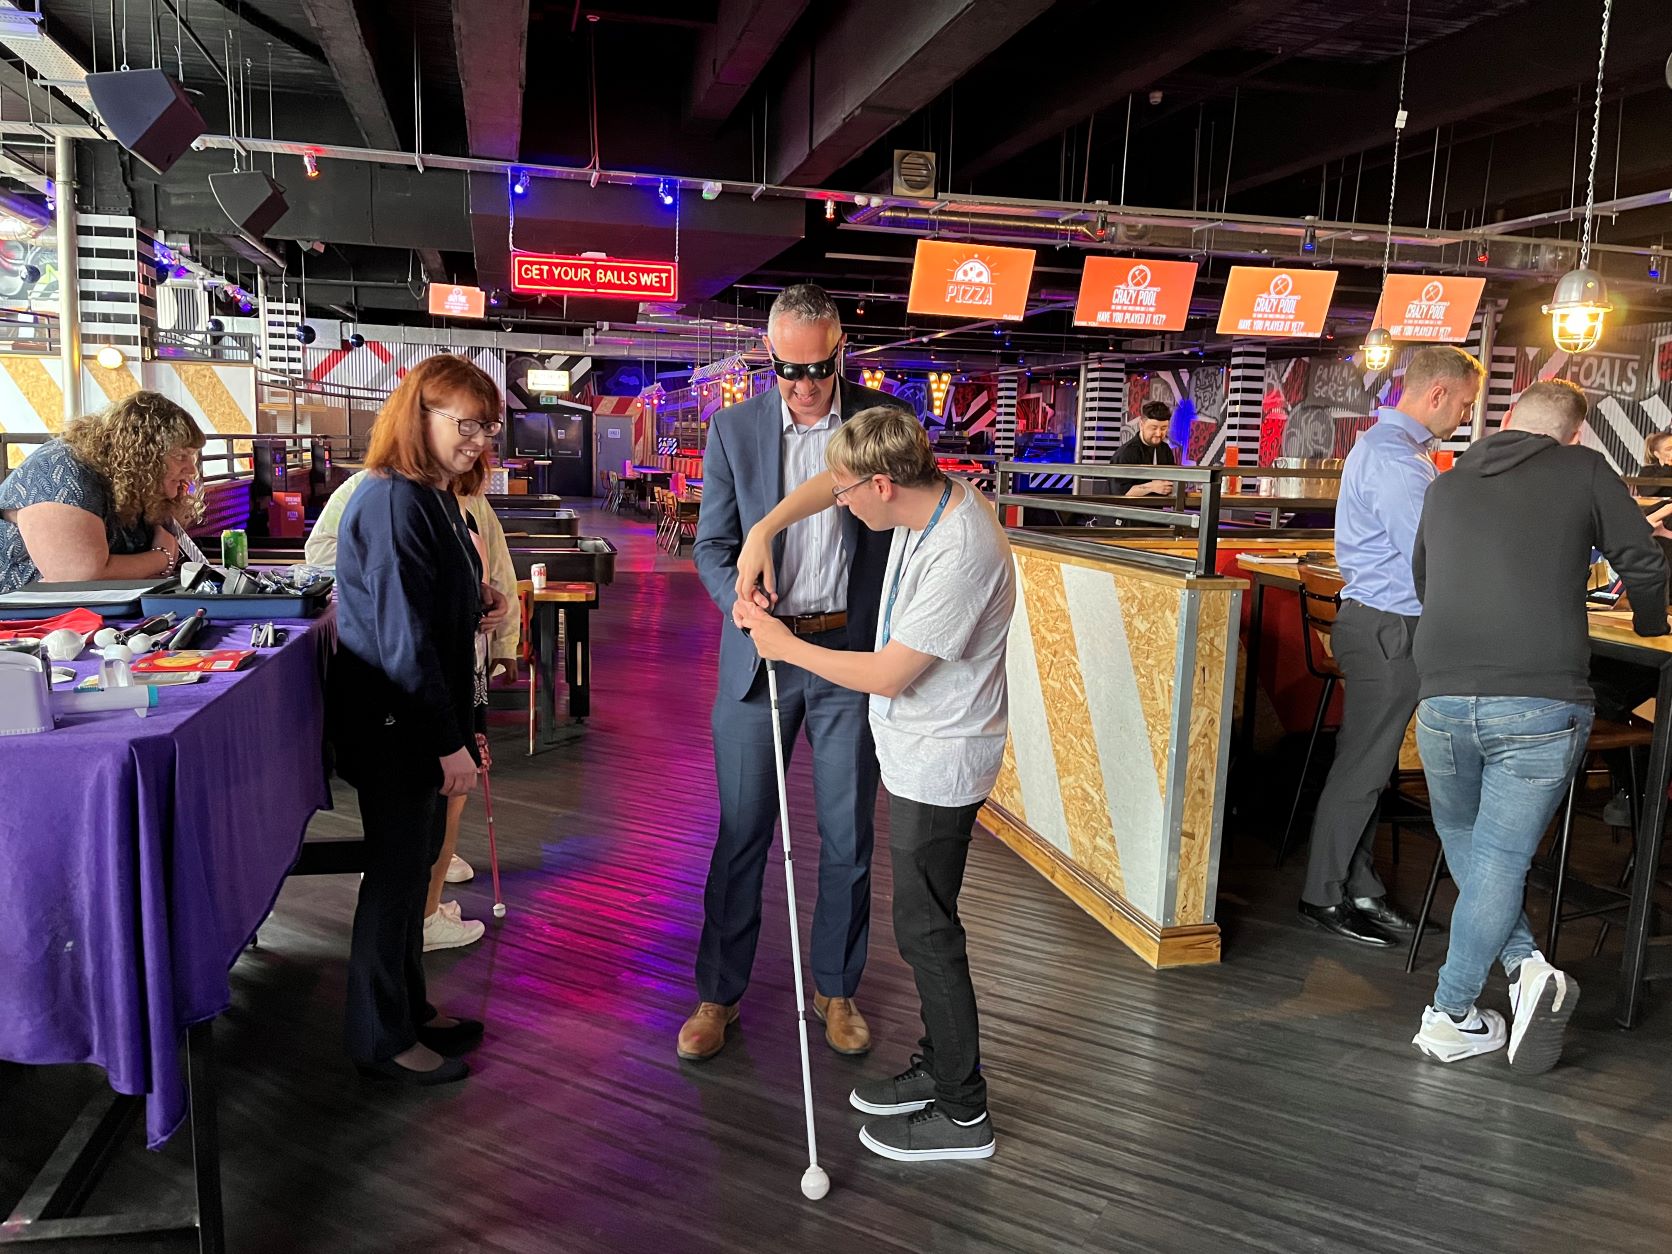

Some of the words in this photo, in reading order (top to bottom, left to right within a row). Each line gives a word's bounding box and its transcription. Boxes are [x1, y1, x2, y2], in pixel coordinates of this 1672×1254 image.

[521, 264, 549, 279] GET
[551, 265, 591, 281] YOUR
[596, 269, 637, 285] BALLS
[639, 272, 669, 287] WET
[945, 284, 993, 305] PIZZA
[1112, 288, 1137, 305] CRAZY
[1137, 290, 1156, 306] POOL
[1253, 297, 1279, 313] CRAZY
[1278, 298, 1297, 314] POOL
[1405, 303, 1430, 319] CRAZY
[1427, 304, 1446, 320] POOL
[1096, 311, 1112, 323] HAVE
[1112, 311, 1124, 324] YOU
[1123, 312, 1146, 325] PLAYED
[1145, 313, 1152, 325] IT
[1152, 314, 1167, 326] YET?
[1566, 356, 1639, 394] FOALS
